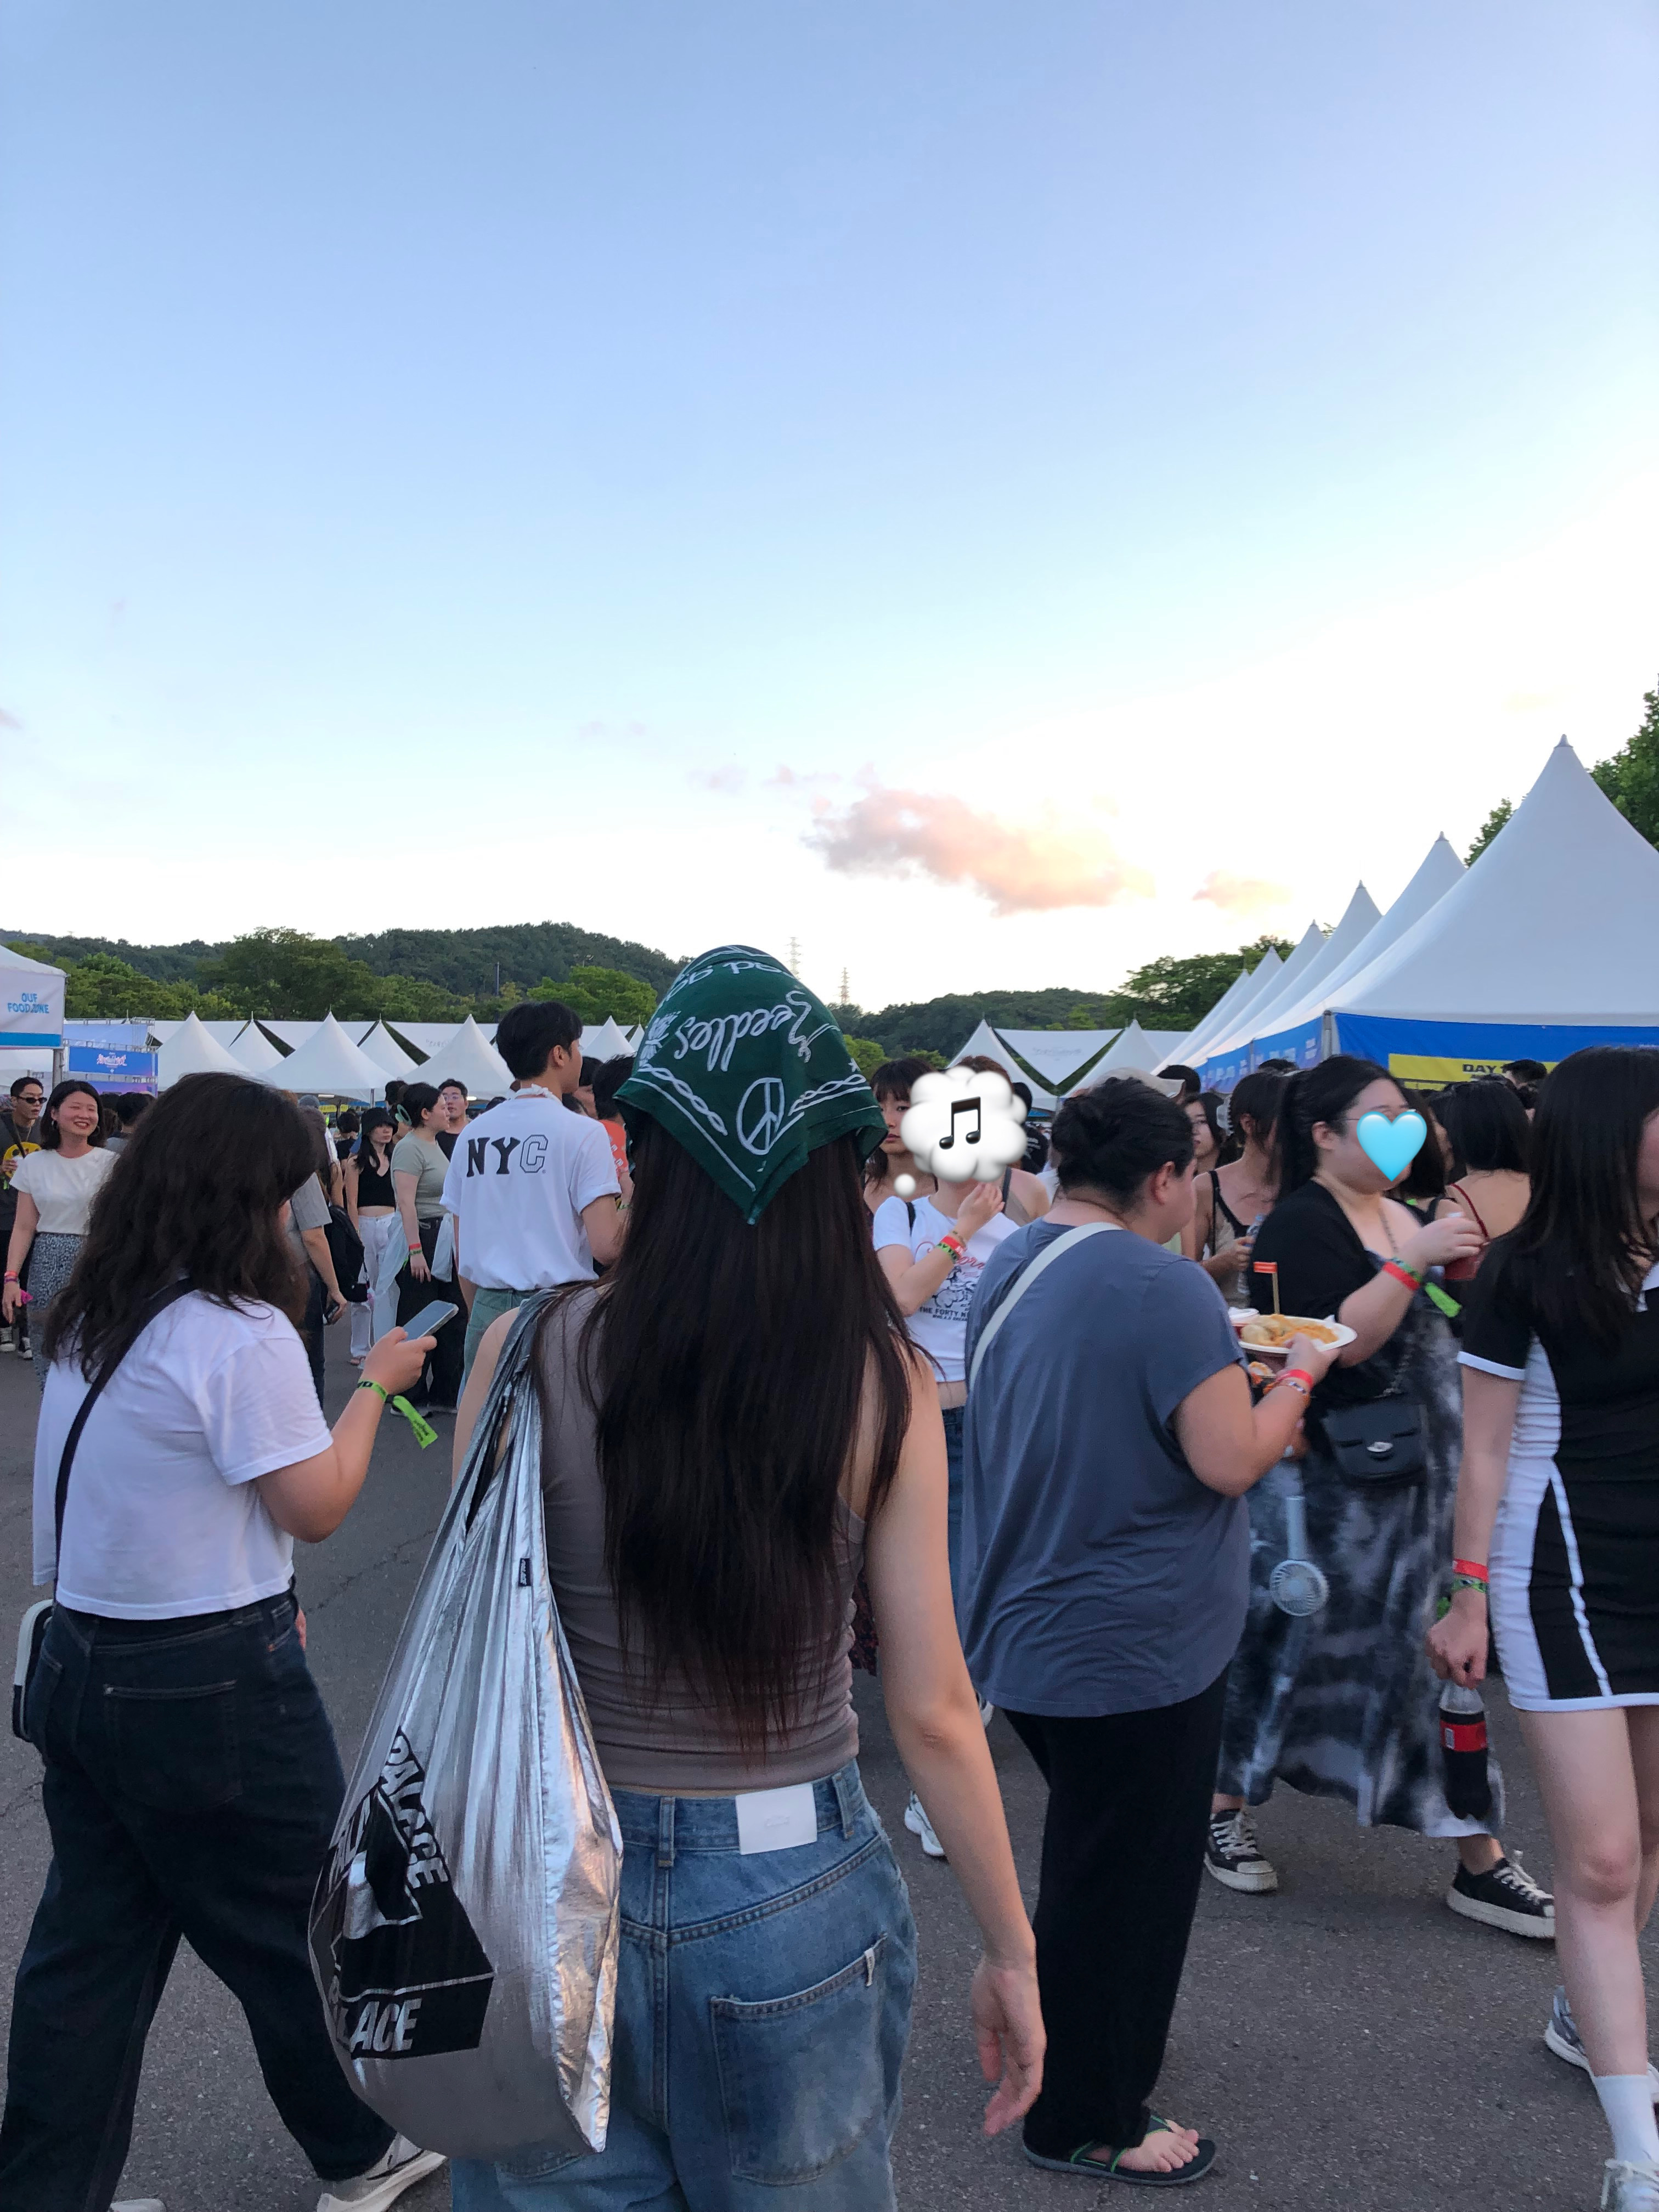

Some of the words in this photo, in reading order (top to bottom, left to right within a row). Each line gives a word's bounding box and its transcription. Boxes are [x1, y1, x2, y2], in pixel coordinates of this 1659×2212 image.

[7, 1002, 30, 1013] FOOD
[1463, 1064, 1497, 1073] DAY
[466, 1134, 549, 1178] NYC
[935, 1308, 959, 1316] FORTY
